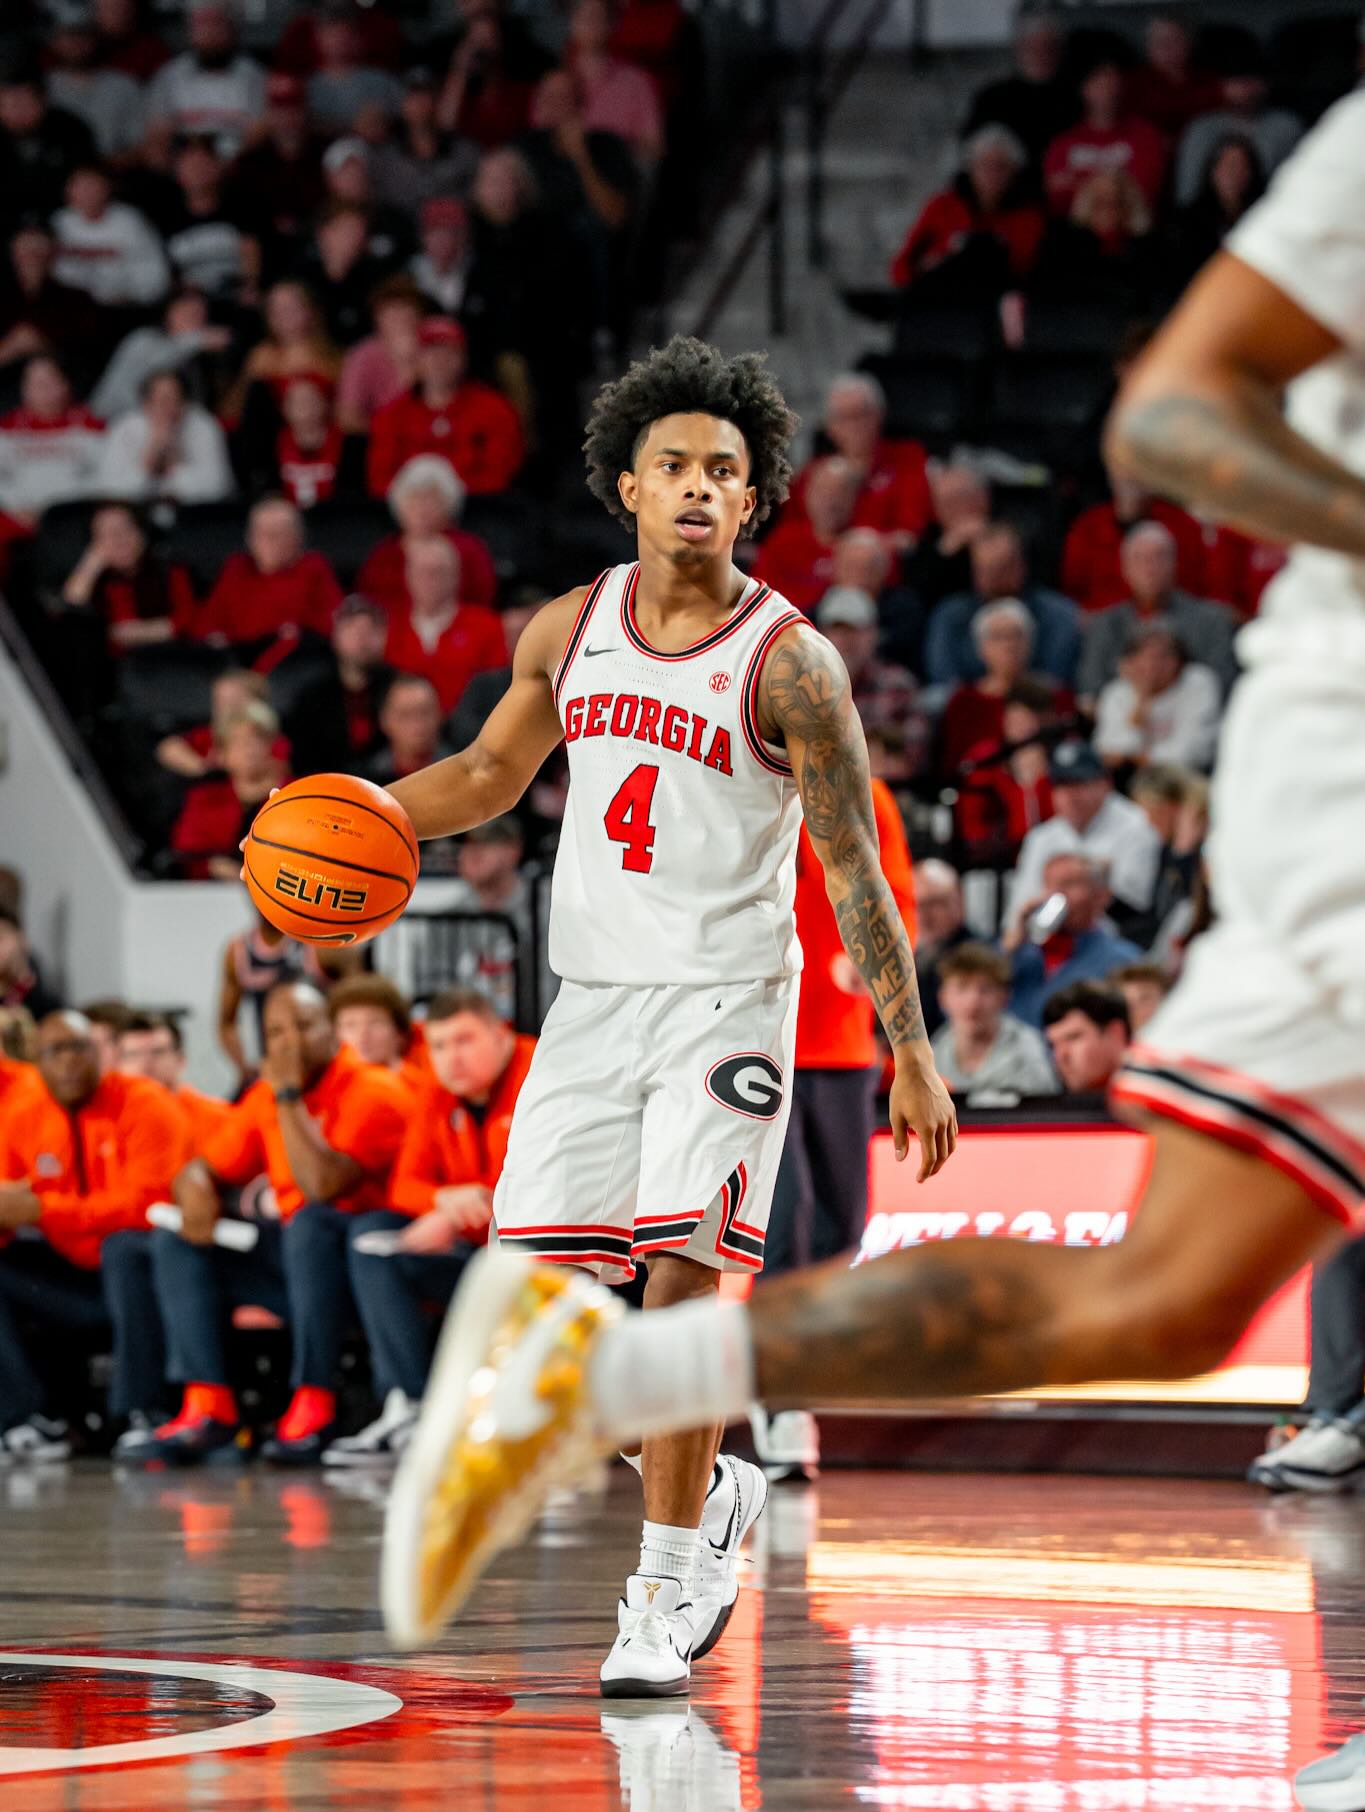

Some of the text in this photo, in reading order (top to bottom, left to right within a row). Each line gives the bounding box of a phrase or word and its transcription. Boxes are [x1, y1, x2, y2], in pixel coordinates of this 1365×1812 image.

[711, 673, 729, 691] SEC
[565, 693, 733, 777] GEORGIA
[604, 763, 659, 874] 4
[275, 868, 367, 912] ELITE
[707, 1054, 783, 1118] G
